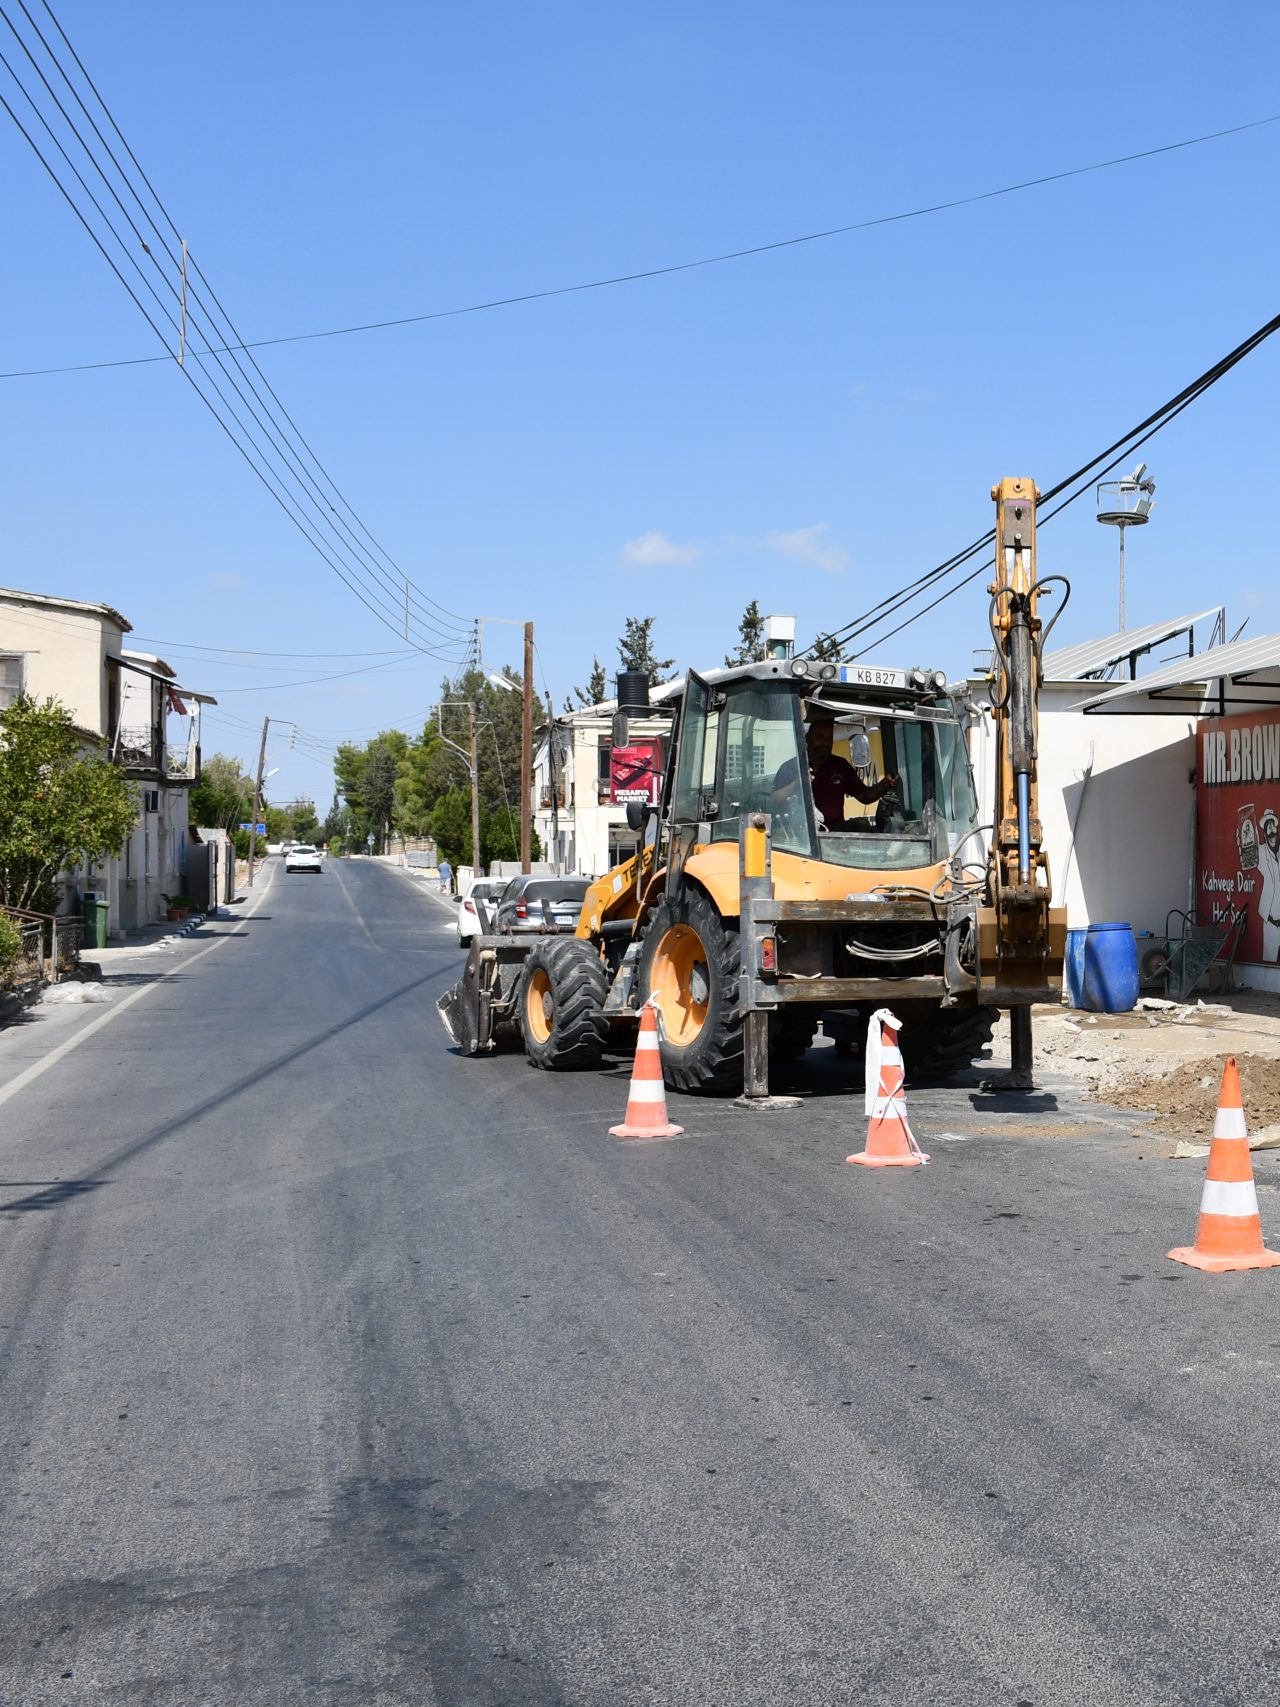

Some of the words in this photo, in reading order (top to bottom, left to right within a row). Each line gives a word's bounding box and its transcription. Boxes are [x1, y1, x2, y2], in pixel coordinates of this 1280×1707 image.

[857, 670, 872, 683] KB
[875, 672, 896, 685] 827
[1202, 870, 1235, 901] Kahveye
[1237, 871, 1256, 893] Dair
